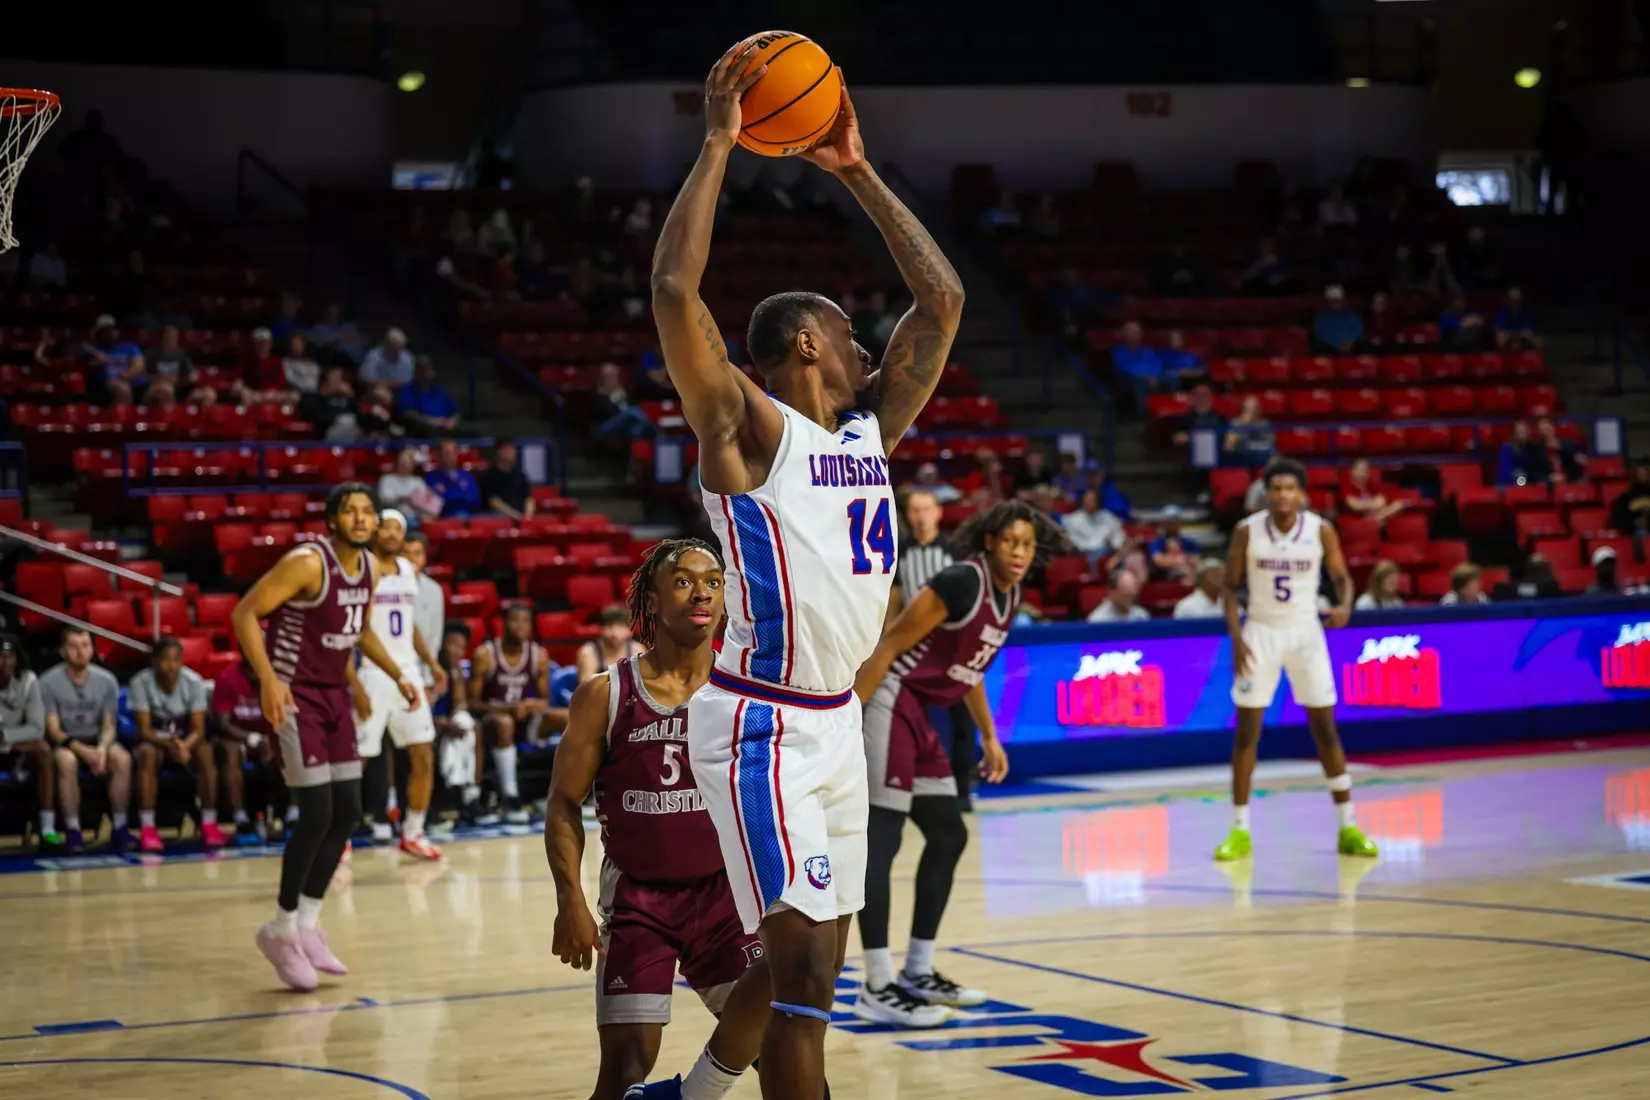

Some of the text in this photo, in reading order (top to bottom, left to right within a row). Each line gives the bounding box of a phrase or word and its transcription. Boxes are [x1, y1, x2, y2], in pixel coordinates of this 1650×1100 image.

[846, 497, 896, 575] 14
[1273, 575, 1292, 603] 5
[388, 609, 404, 637] 0
[627, 717, 689, 742] DALL
[659, 742, 684, 786] 5
